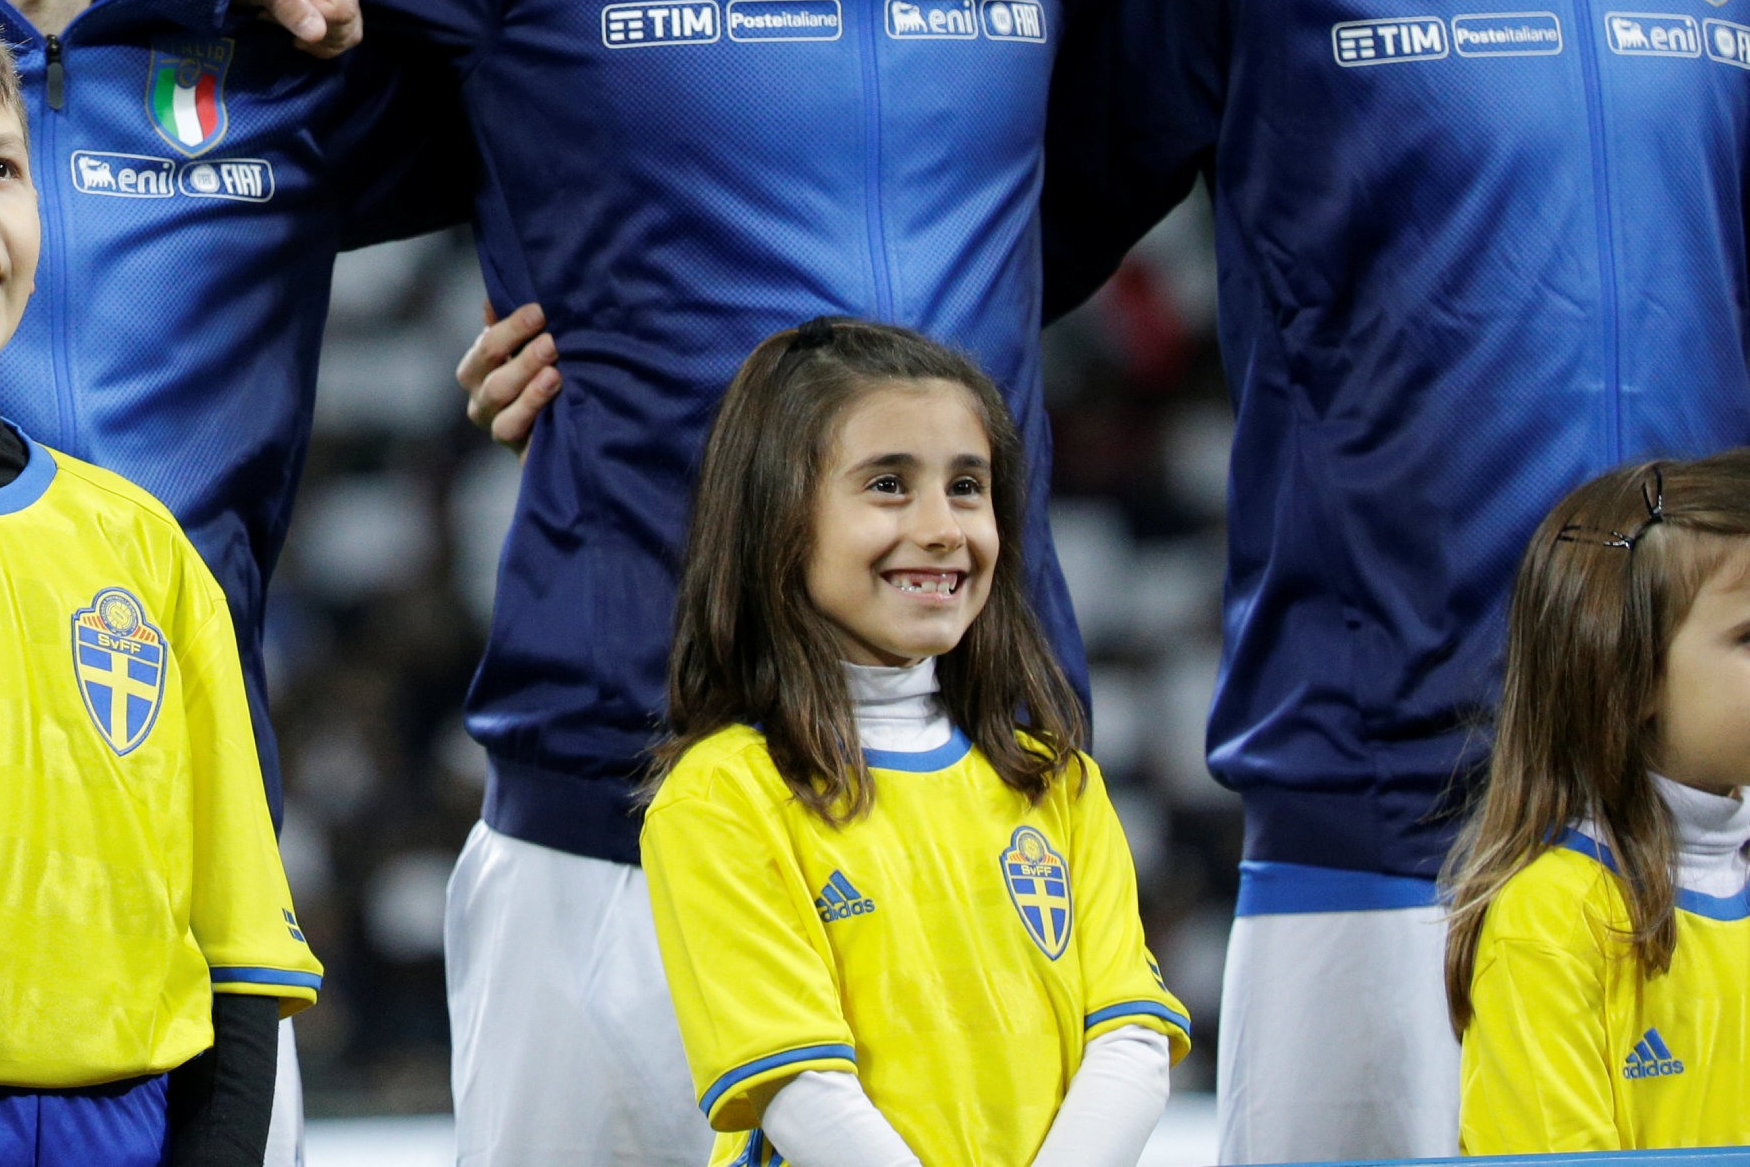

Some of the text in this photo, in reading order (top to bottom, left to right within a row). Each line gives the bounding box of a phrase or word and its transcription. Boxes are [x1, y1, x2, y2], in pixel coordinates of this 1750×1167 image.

[647, 7, 713, 38] TIM
[731, 10, 837, 29] Posteitaliane
[928, 0, 973, 33] eni
[1011, 3, 1041, 38] FIAT
[1377, 24, 1442, 56] TIM
[1458, 26, 1558, 45] Posteitaliane
[1650, 19, 1696, 51] eni
[118, 162, 168, 194] eni
[221, 164, 262, 197] FIAT
[97, 633, 142, 654] SvFF
[1623, 1060, 1684, 1079] adidas
